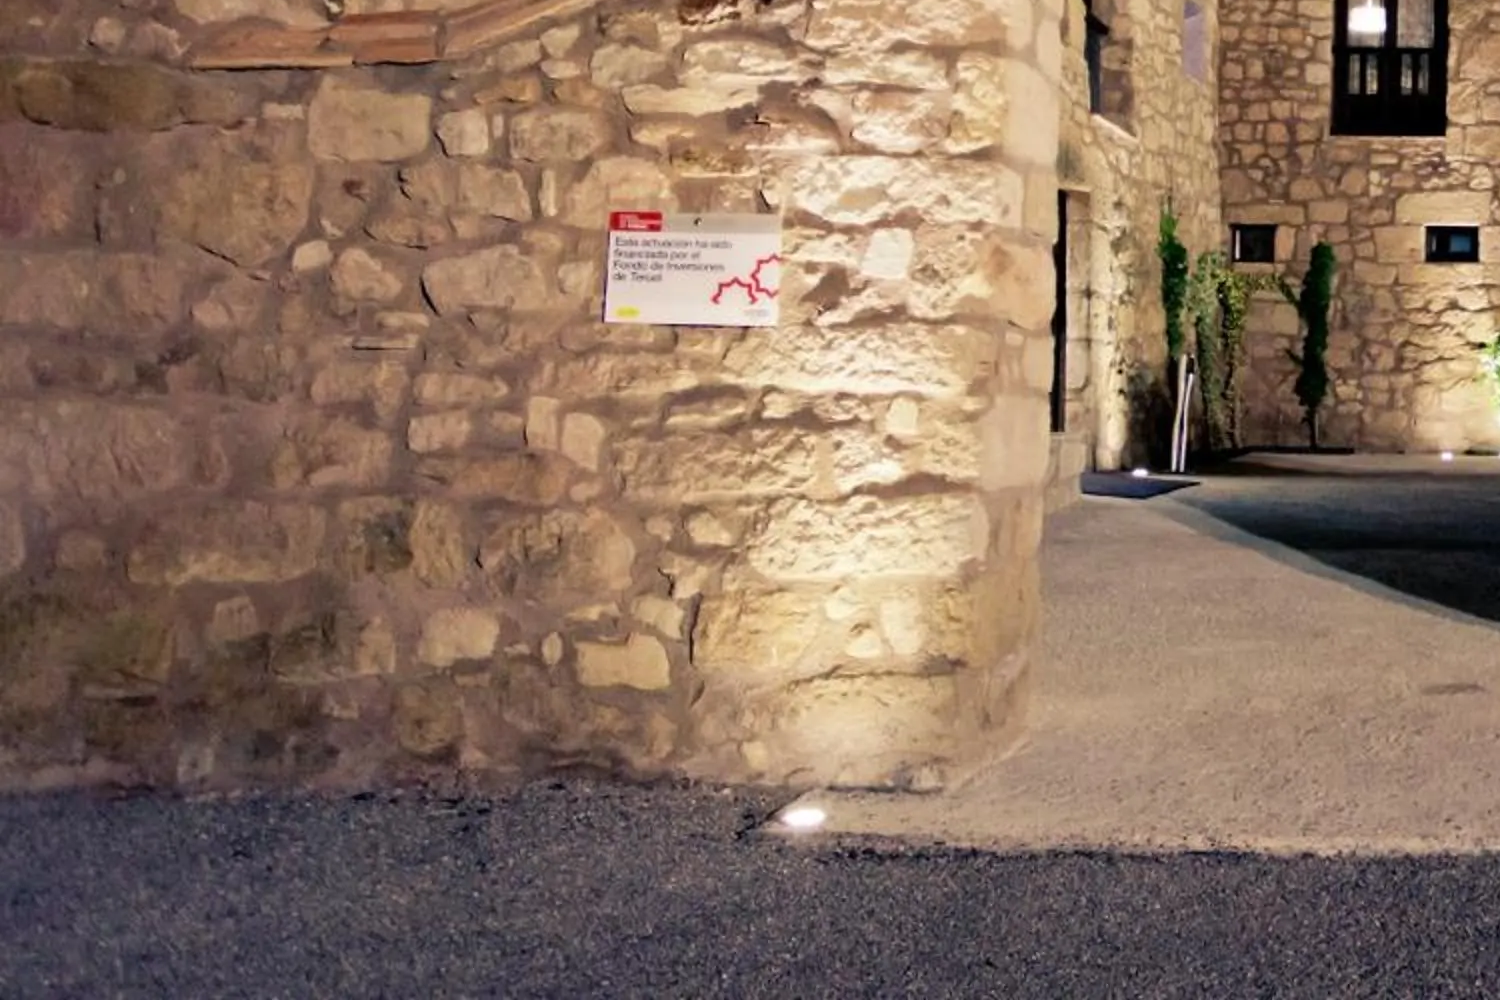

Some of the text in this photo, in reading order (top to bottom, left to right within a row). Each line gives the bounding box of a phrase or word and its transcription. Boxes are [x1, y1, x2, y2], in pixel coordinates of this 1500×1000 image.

[695, 240, 707, 248] ha
[614, 249, 668, 259] financiada
[670, 251, 687, 260] por
[613, 260, 725, 271] Fondo de Inversiones
[613, 272, 662, 282] de Teruel
